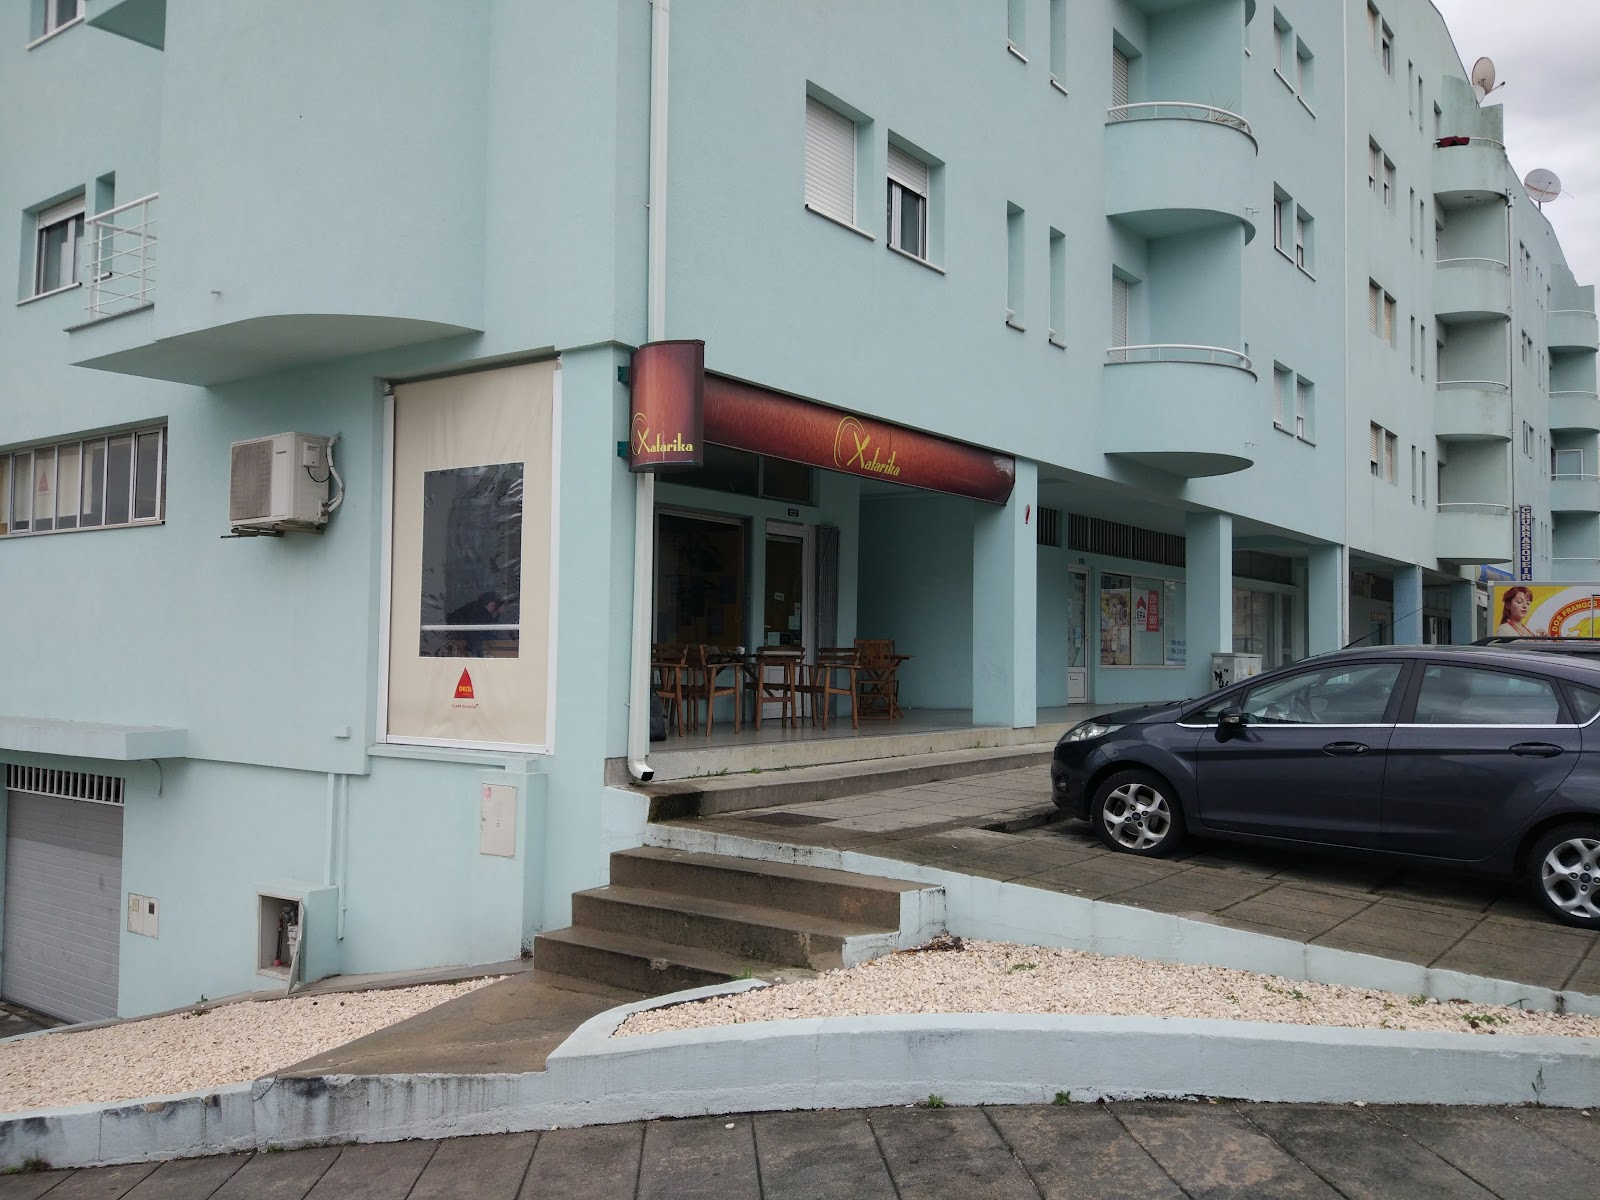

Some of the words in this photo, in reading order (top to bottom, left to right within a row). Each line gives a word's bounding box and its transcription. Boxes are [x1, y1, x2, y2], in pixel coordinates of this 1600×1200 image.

[637, 426, 693, 455] Xafarika
[846, 425, 901, 476] Xafarika
[1521, 506, 1531, 582] CHURRASQUEIR
[1136, 610, 1146, 619] ERA
[1551, 615, 1563, 632] DOS
